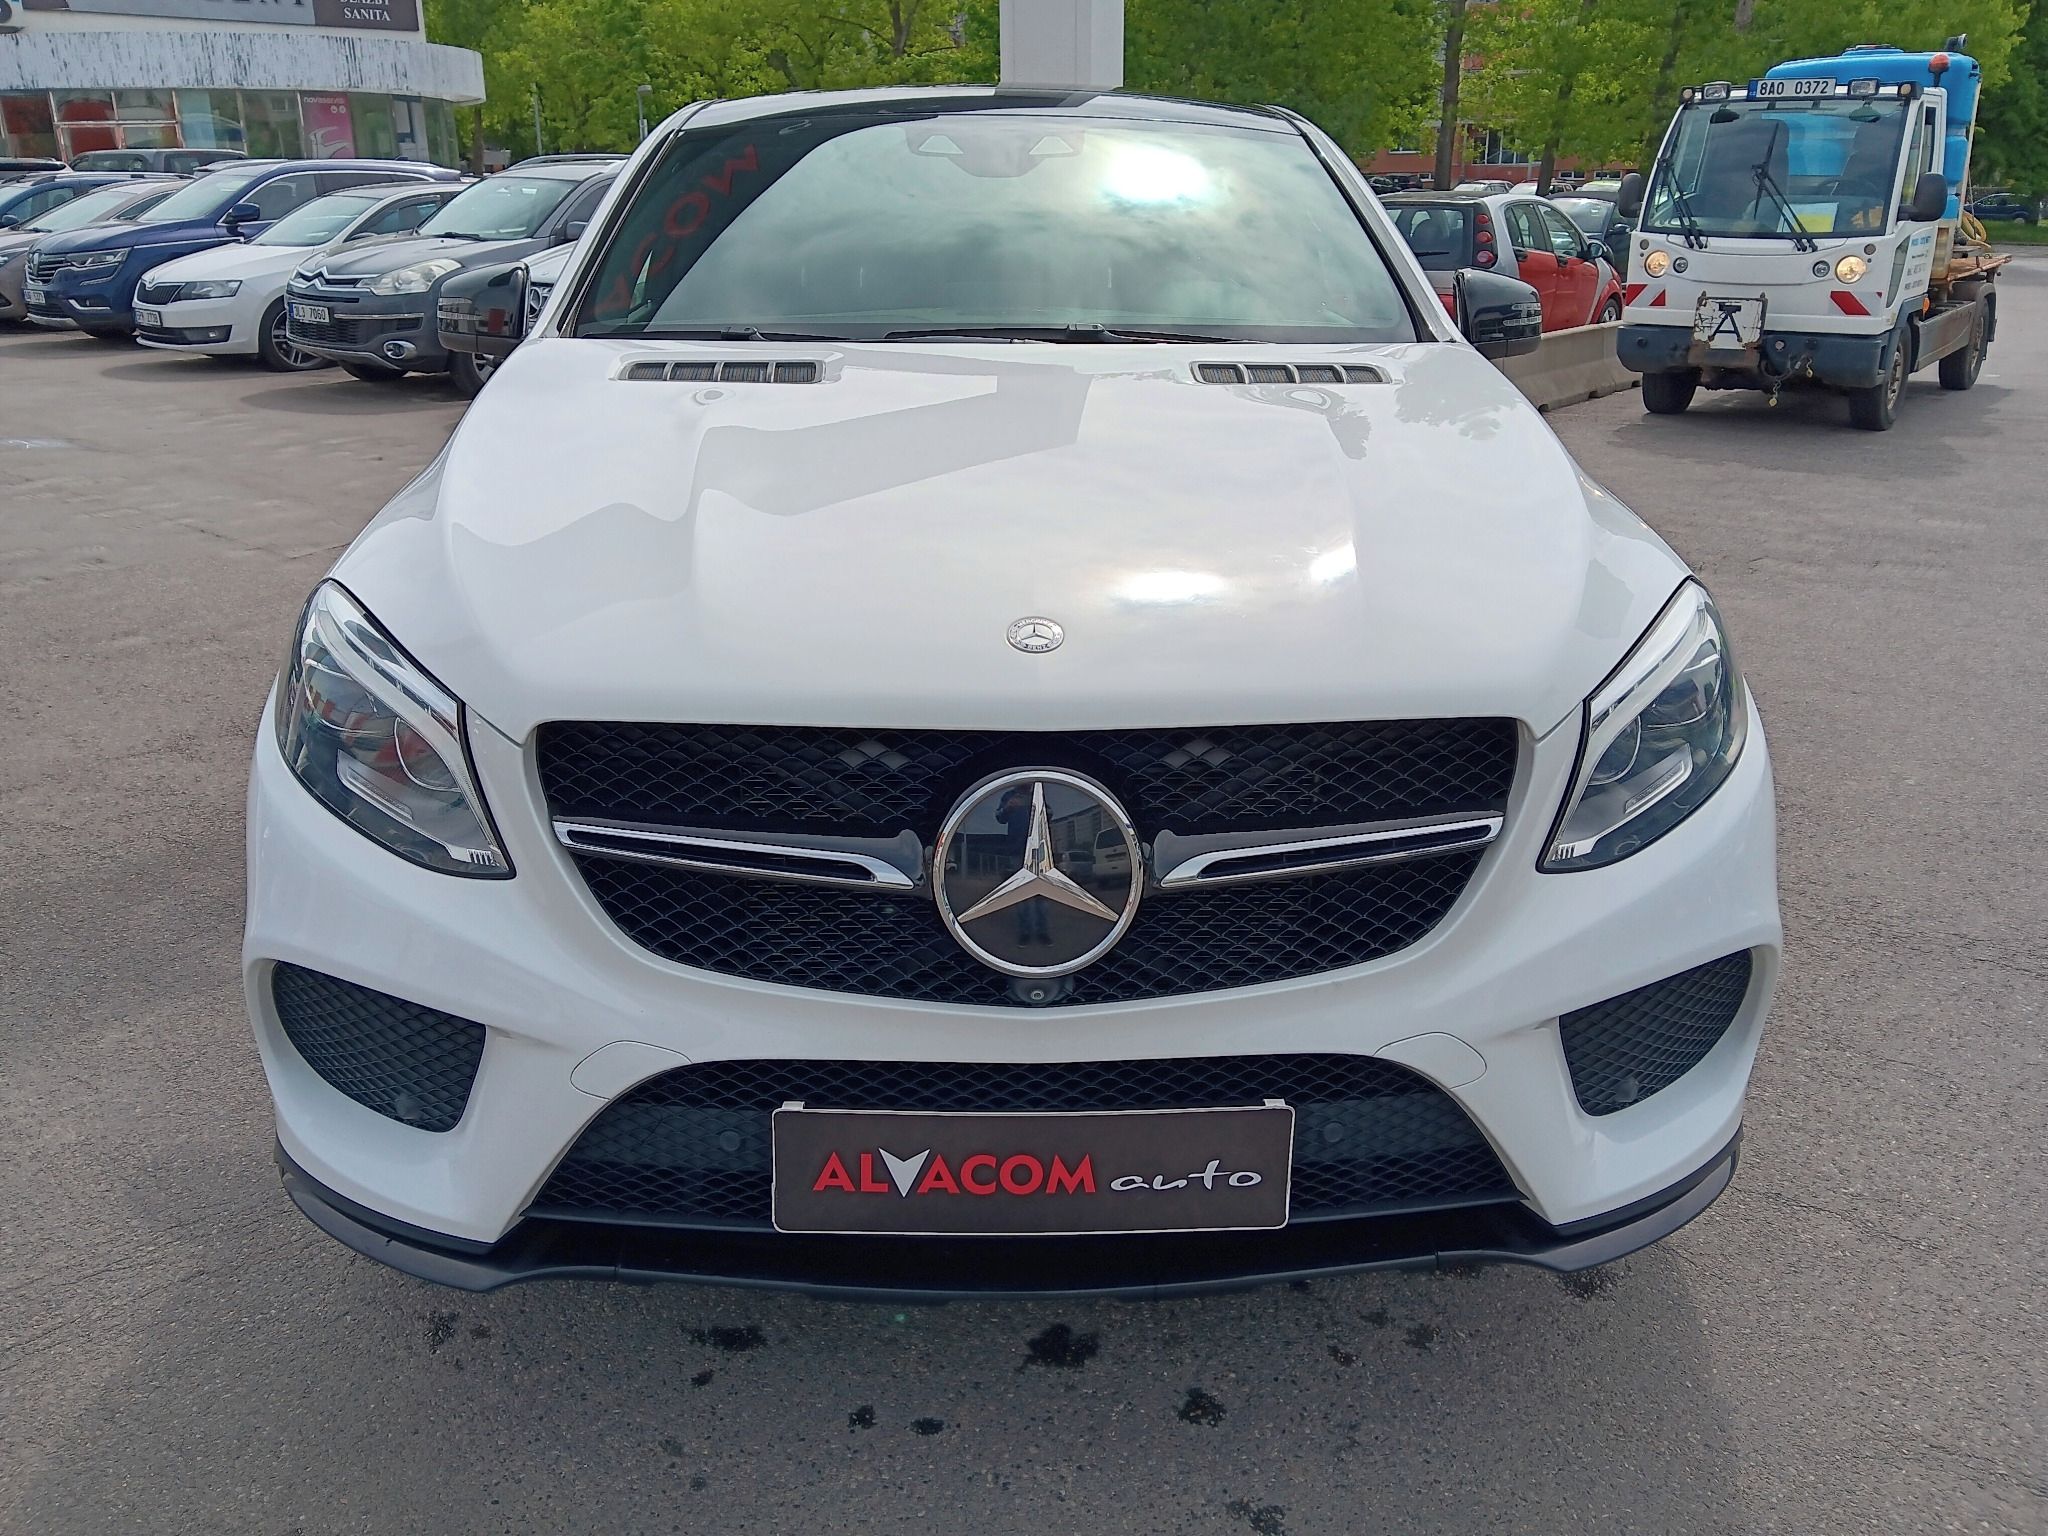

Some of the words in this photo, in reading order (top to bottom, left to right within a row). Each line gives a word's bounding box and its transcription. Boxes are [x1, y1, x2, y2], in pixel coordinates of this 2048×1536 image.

[344, 7, 391, 21] SANITA
[1760, 82, 1785, 95] 8A0
[1795, 81, 1829, 94] 0372
[812, 1148, 1096, 1198] ALVACOM
[1110, 1160, 1263, 1191] auto
